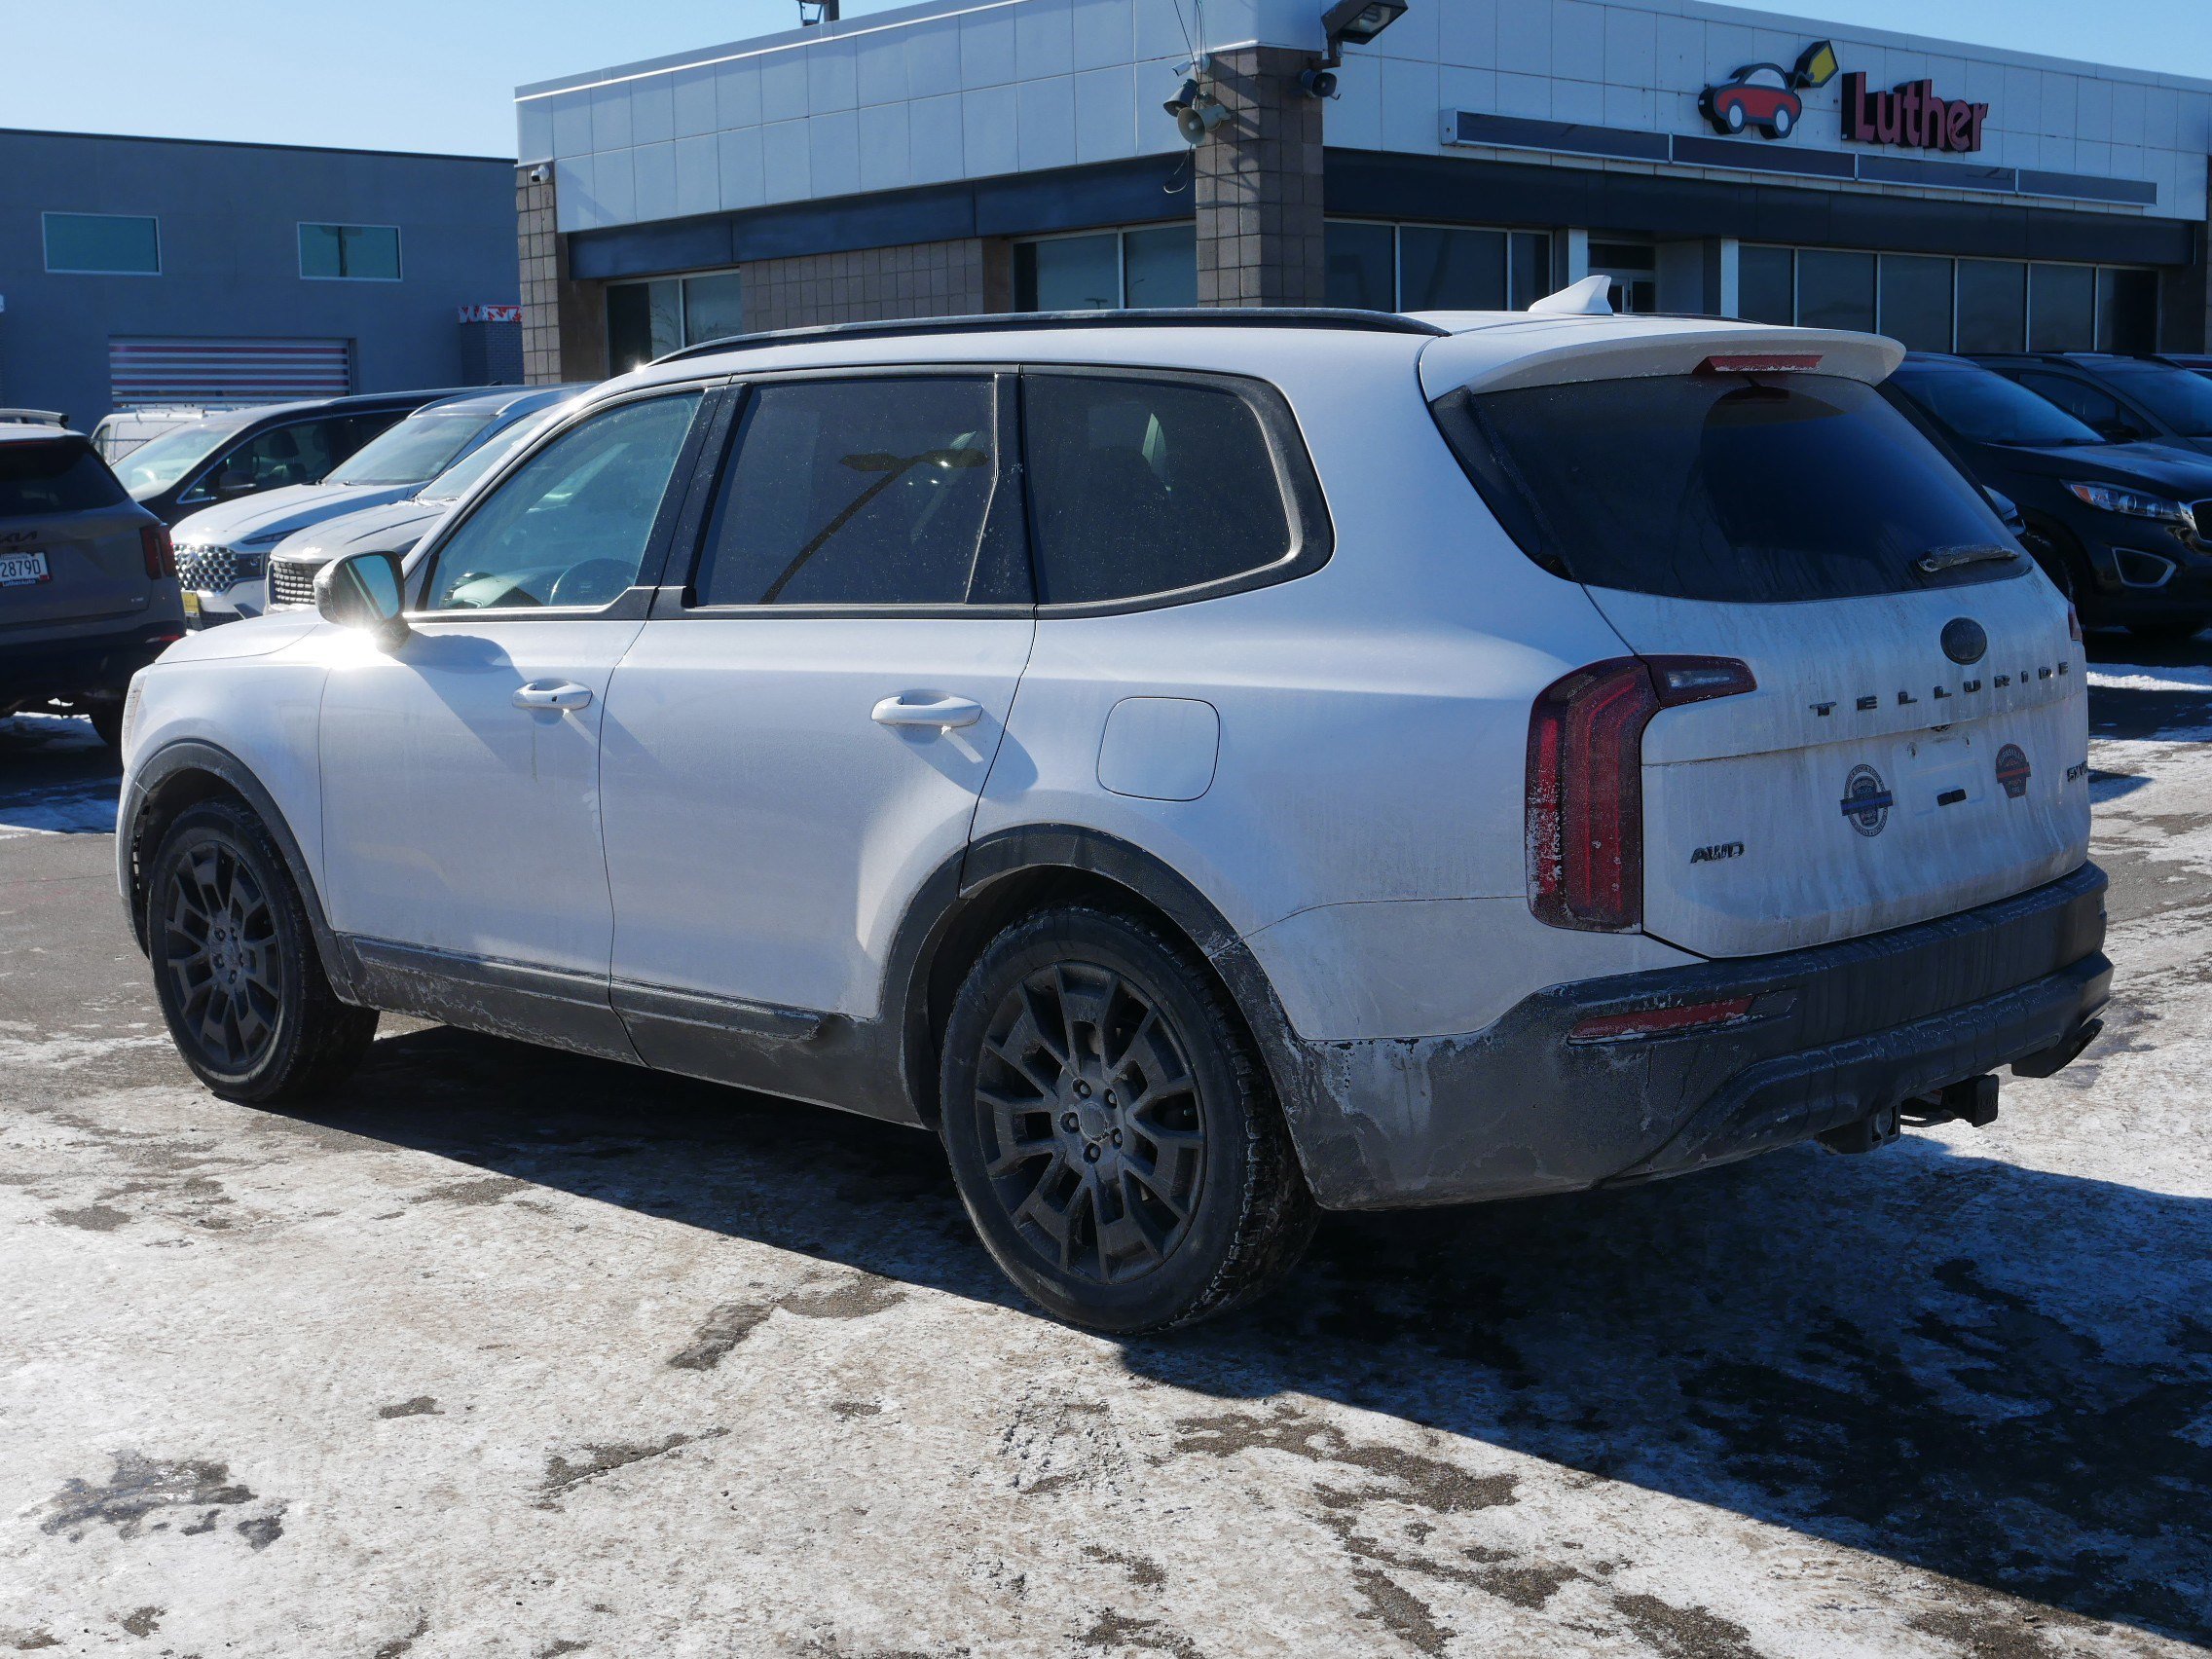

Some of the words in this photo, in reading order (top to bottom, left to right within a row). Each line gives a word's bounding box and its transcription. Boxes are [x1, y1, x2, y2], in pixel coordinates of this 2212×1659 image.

[1851, 72, 1989, 153] Luther
[1809, 661, 2069, 718] TELLURIDE
[1690, 841, 1745, 864] AWD
